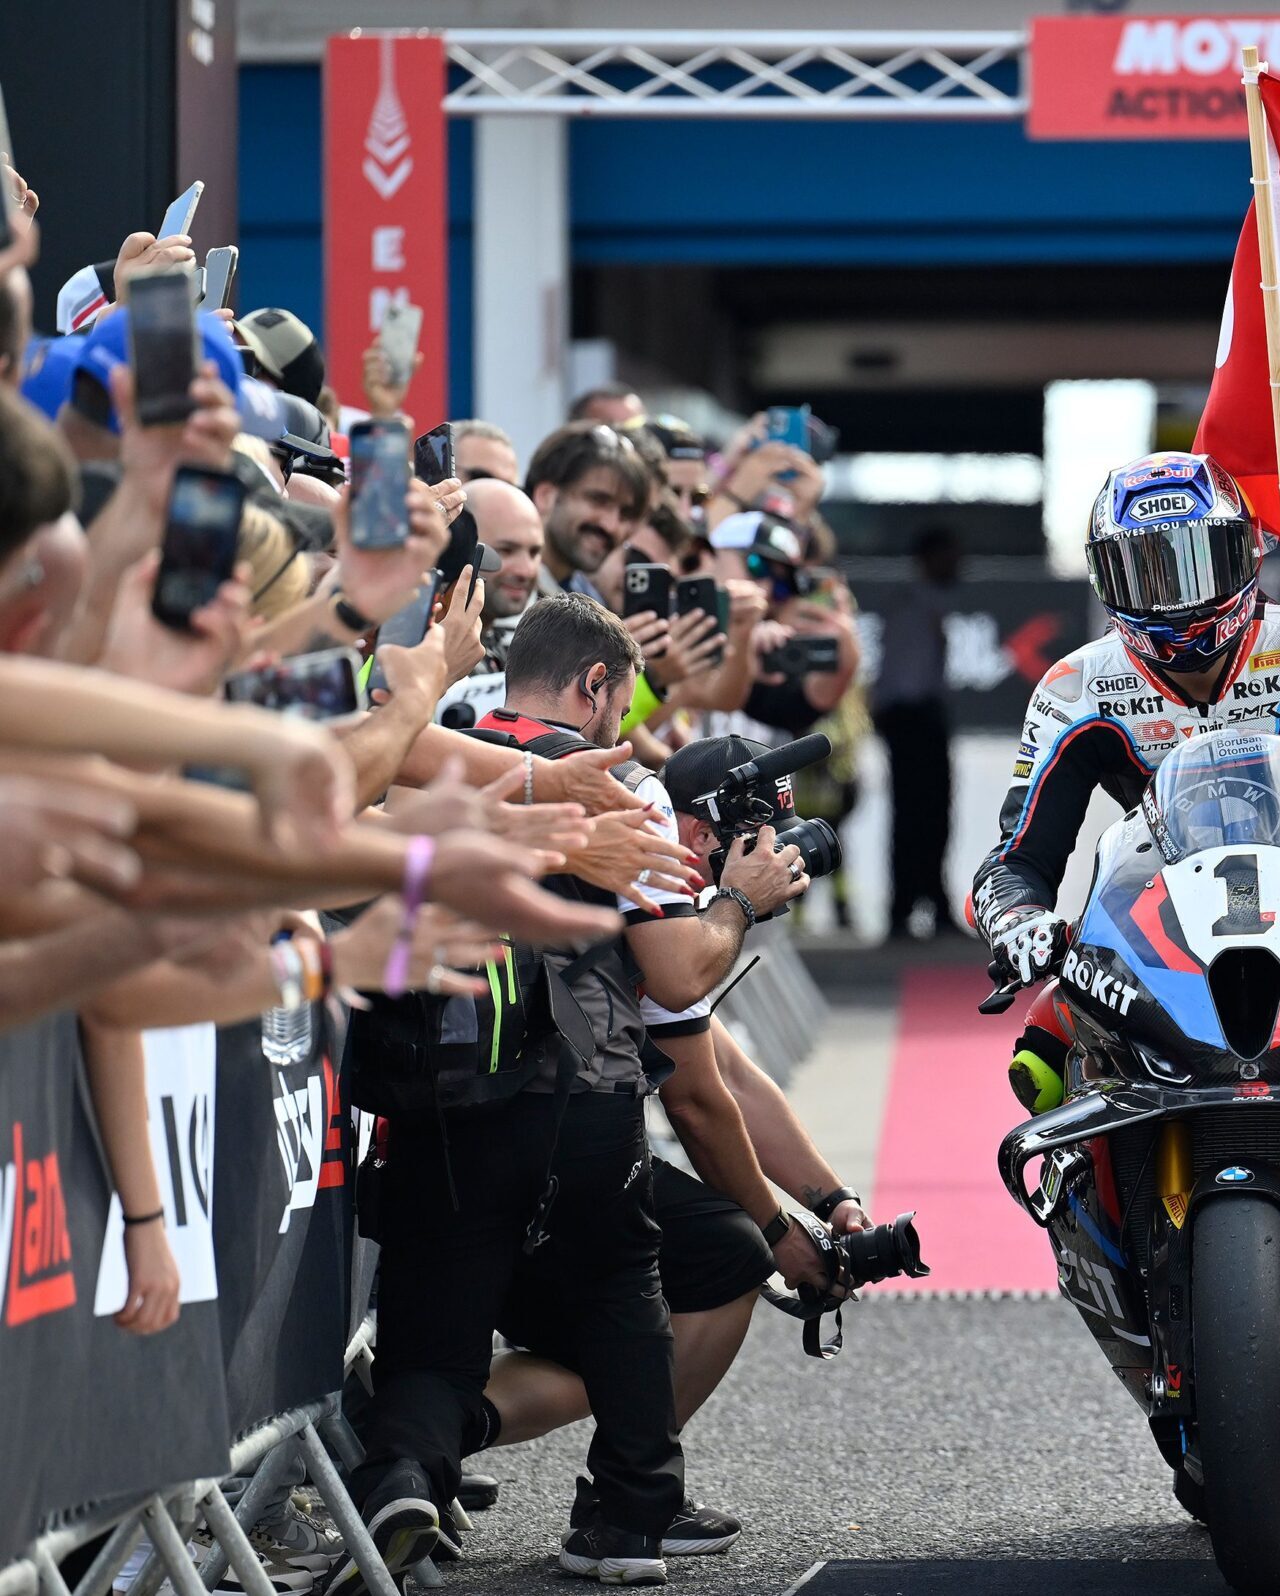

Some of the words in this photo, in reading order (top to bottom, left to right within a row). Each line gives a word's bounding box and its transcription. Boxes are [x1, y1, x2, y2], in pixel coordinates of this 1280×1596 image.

[1137, 496, 1188, 517] SHOEI
[1113, 527, 1146, 542] GIVES
[1152, 521, 1181, 533] YOU
[1186, 517, 1229, 528] WINGS
[1215, 605, 1250, 648] Red
[1095, 676, 1139, 693] SHOEI
[1217, 737, 1262, 749] Borusan
[1219, 743, 1269, 757] Otomotiv
[1212, 853, 1275, 937] 1
[1062, 949, 1139, 1017] ROKiT
